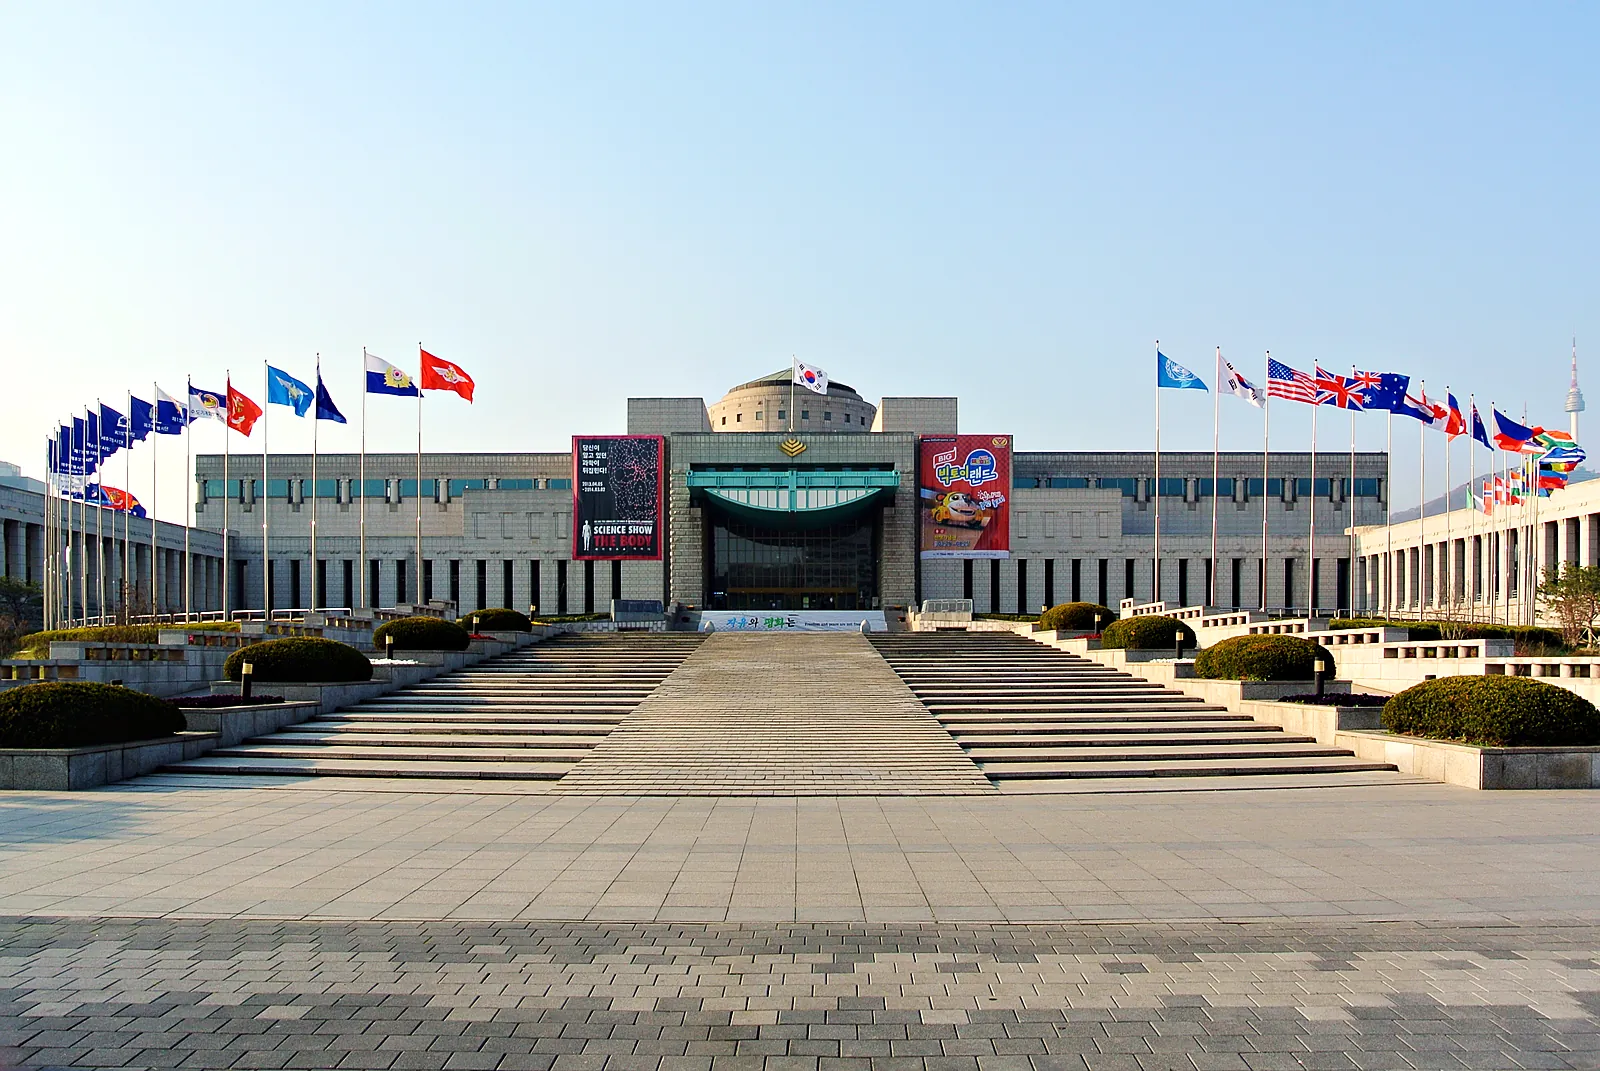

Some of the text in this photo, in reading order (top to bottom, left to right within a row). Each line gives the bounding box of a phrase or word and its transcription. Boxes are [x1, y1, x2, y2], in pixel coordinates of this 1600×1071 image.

[938, 453, 952, 462] BIG
[937, 465, 997, 485] 빅토이랜드
[594, 526, 653, 534] SCIENCE SHOW
[594, 535, 652, 546] THE BODY
[727, 617, 796, 628] 자유와 평화는
